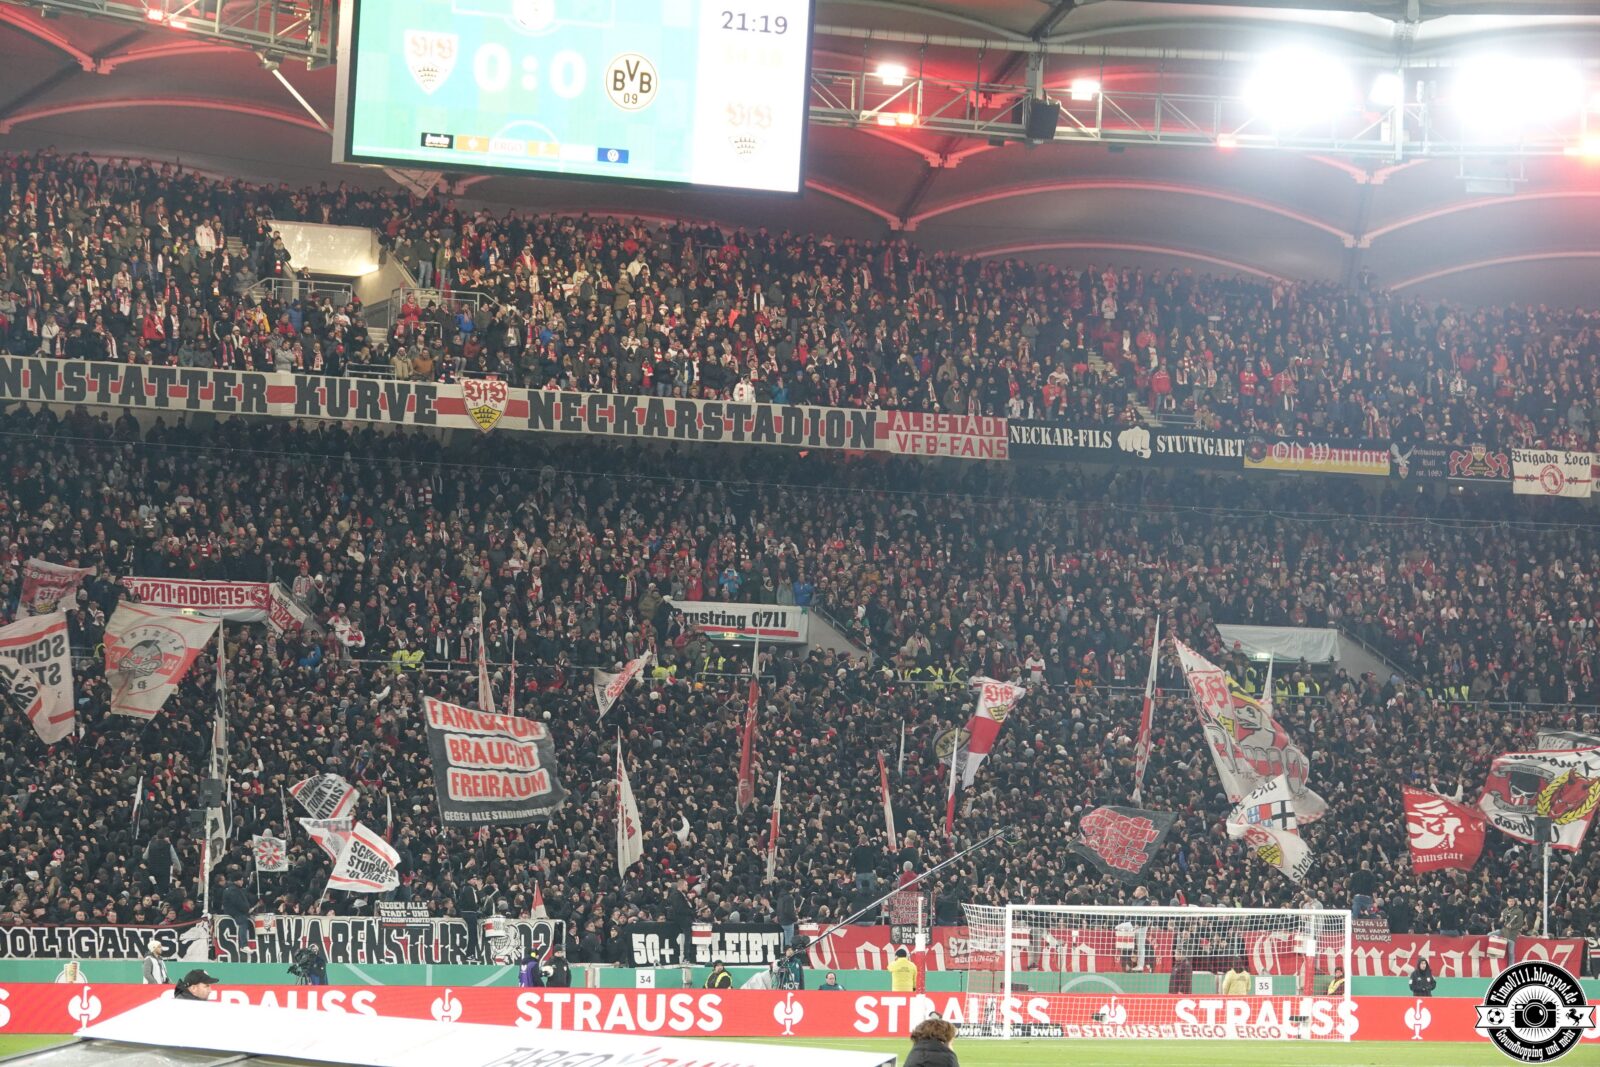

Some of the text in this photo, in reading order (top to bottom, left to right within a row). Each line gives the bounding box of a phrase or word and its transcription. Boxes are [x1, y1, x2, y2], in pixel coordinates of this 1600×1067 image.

[721, 10, 788, 35] 21:19
[613, 59, 652, 94] BVB
[623, 92, 638, 105] 09
[294, 375, 438, 425] KURVE
[527, 390, 876, 449] NECKARSTADION
[893, 410, 1008, 437] ALBSTADT
[895, 433, 1007, 458] VFB-FANS
[1009, 425, 1112, 449] NECKAR-FILS
[1156, 435, 1245, 457] STUTTGART
[1272, 441, 1305, 464] Old
[1308, 442, 1390, 468] Warriors
[1512, 450, 1558, 466] Brigada
[1564, 451, 1590, 466] Loca
[141, 583, 245, 606] 0711 ADDICTS
[672, 608, 787, 631] rustring 0711
[449, 738, 536, 768] BRAUCHT
[451, 771, 547, 798] FREIRAUM
[444, 810, 471, 821] GEGEN
[472, 810, 492, 821] ALLE
[380, 901, 428, 910] GEGEN ALLE
[631, 931, 785, 965] 50+1 BLEIBT!
[640, 975, 652, 984] 34
[1258, 982, 1270, 990] 35
[514, 992, 724, 1032] STRAUSS
[1030, 1025, 1063, 1037] bwin
[1084, 1024, 1159, 1038] STRAUSS
[1181, 1025, 1226, 1039] ERGO
[1236, 1025, 1281, 1039] ERGO
